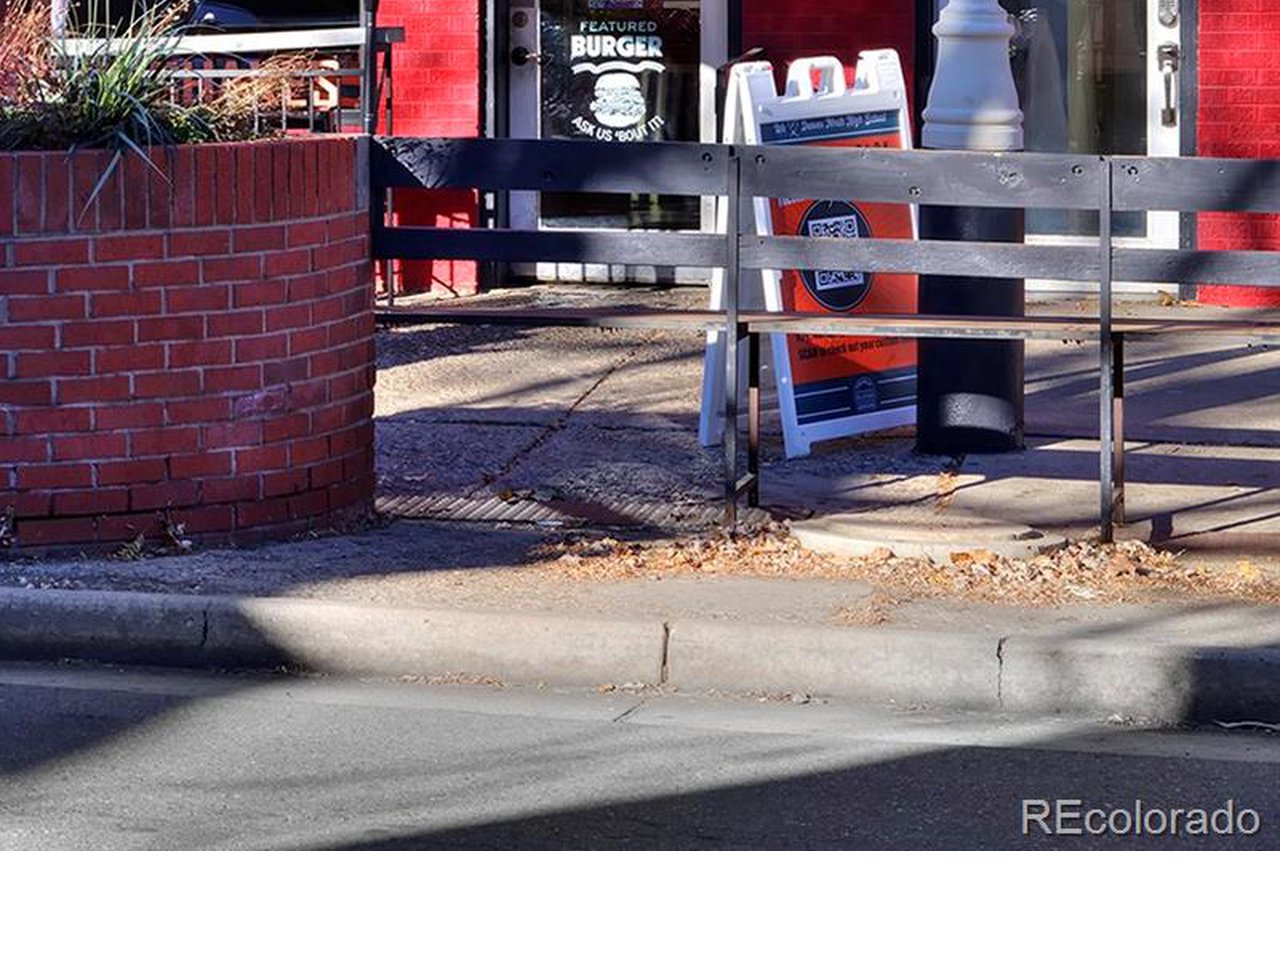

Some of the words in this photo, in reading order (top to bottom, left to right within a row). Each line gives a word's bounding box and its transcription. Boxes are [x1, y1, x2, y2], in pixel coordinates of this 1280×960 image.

[580, 21, 658, 33] FEATURED
[570, 34, 664, 60] BURGER
[571, 116, 596, 137] ASK
[596, 127, 613, 142] US
